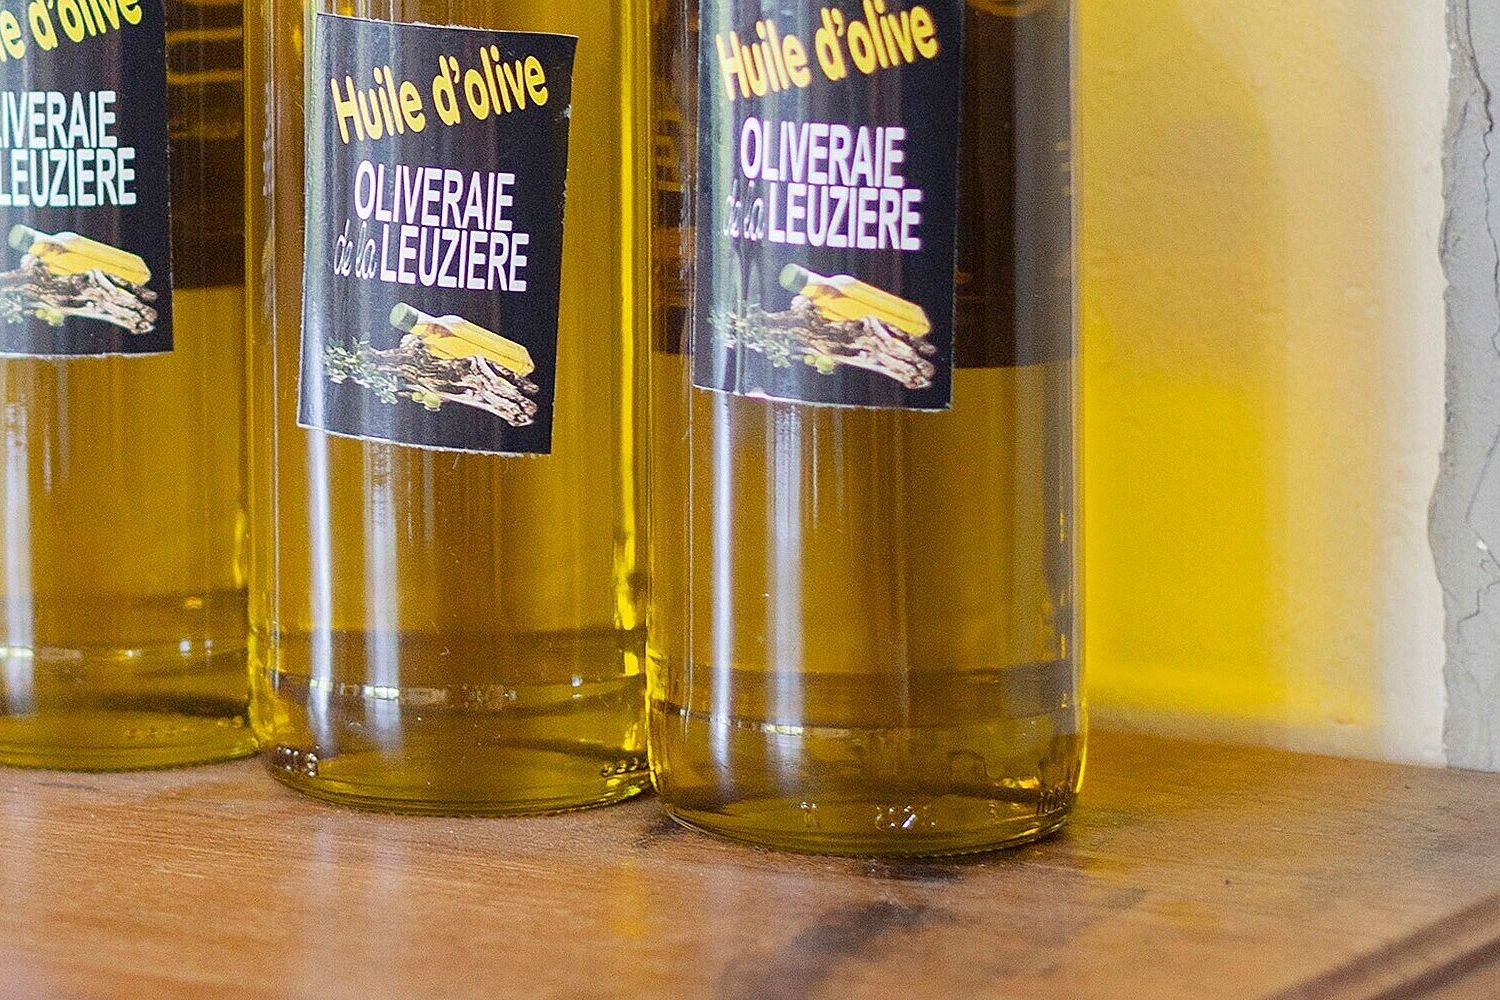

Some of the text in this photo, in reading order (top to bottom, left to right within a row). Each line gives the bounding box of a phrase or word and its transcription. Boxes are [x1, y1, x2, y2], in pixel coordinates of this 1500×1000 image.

[330, 45, 548, 144] Huile d'olive
[716, 18, 812, 101] Huile
[740, 117, 905, 188] OLIVERAIE
[354, 160, 515, 231] OLIVERAIE
[768, 182, 922, 250] LEUZIERE
[333, 218, 530, 292] de la LEUZIERE
